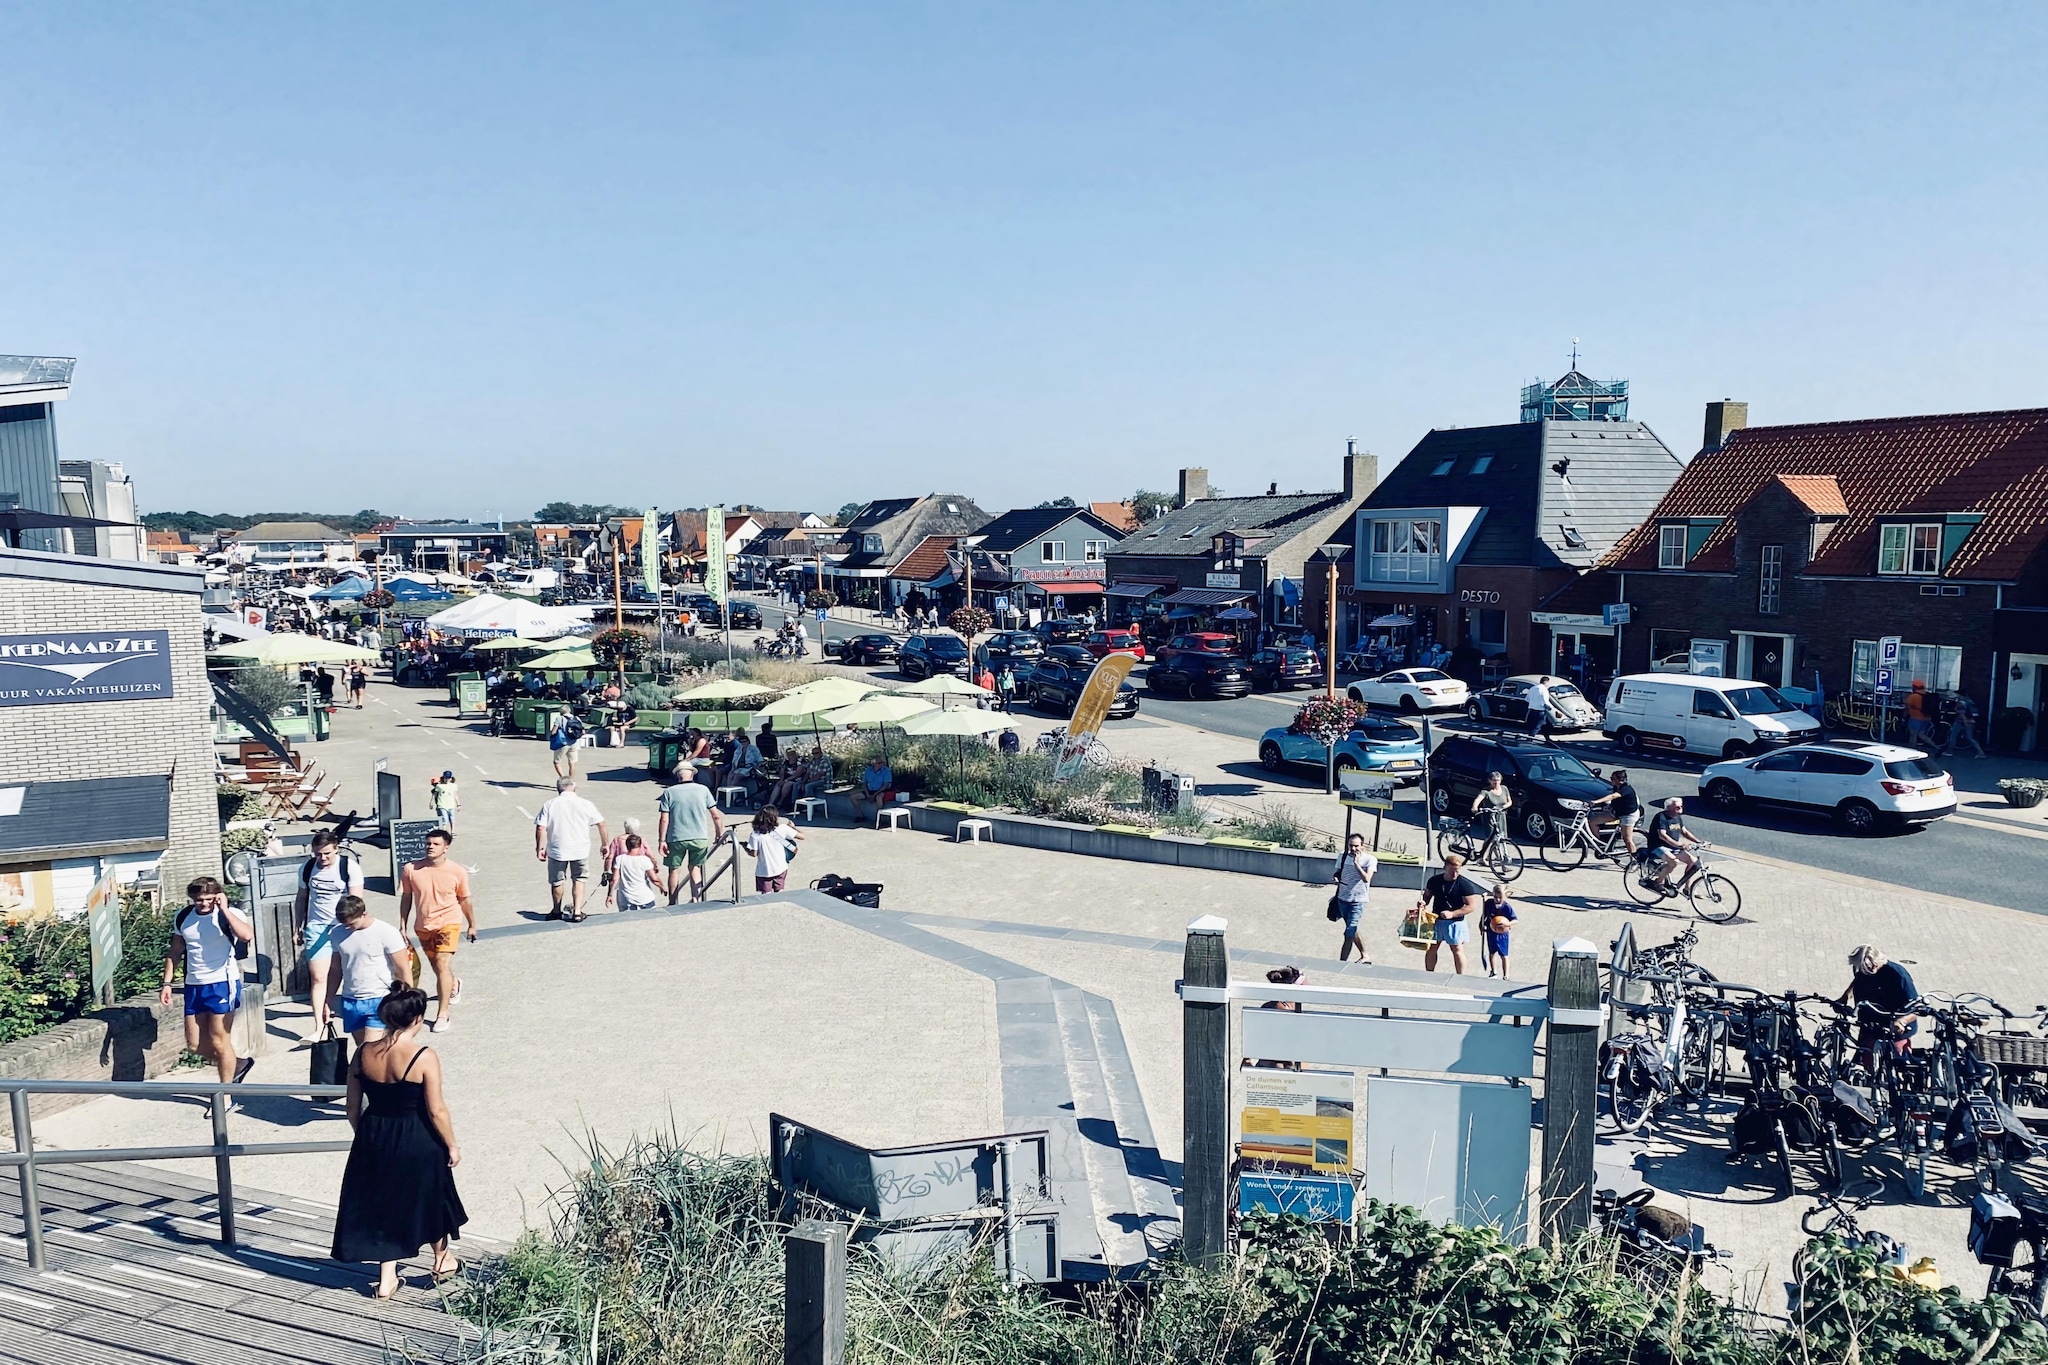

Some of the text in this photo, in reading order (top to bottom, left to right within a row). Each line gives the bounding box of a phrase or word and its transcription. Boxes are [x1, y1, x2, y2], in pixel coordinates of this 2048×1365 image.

[1324, 584, 1355, 596] DSTO
[1460, 590, 1500, 603] DESTO
[464, 629, 515, 638] Heineken
[0, 638, 159, 657] KERNAARZEE
[1887, 645, 1895, 657] P
[1879, 671, 1889, 684] P
[35, 683, 162, 697] VAKANTIEHUIZEN
[1246, 1075, 1256, 1083] De
[1257, 1076, 1282, 1085] duinen
[1246, 1083, 1288, 1093] Callantsoog
